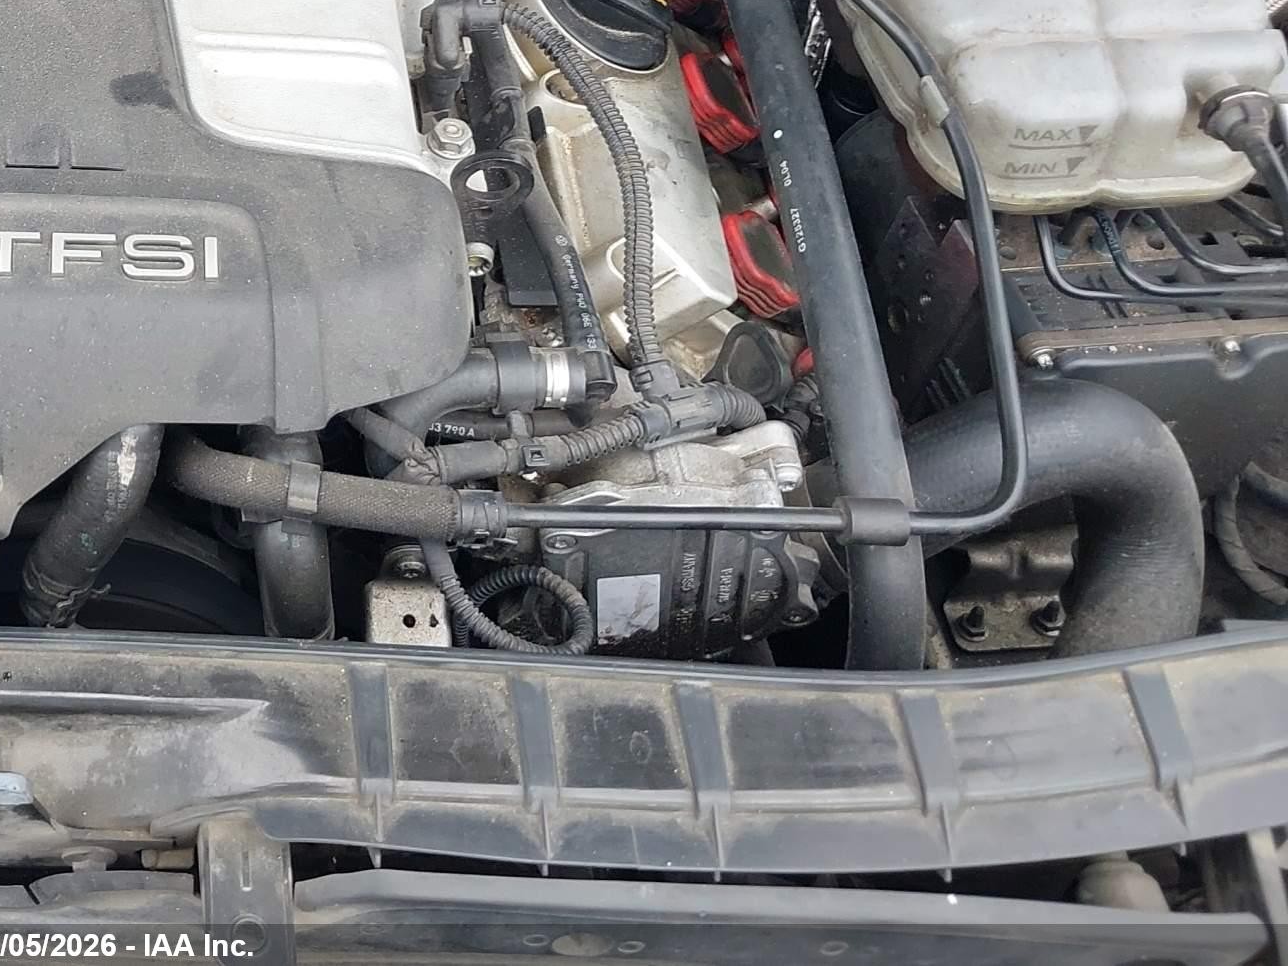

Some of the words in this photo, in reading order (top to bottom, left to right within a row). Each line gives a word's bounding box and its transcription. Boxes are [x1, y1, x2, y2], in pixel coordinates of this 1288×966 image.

[1013, 128, 1073, 142] MAX
[1004, 161, 1058, 175] MIN
[562, 254, 578, 288] Germany
